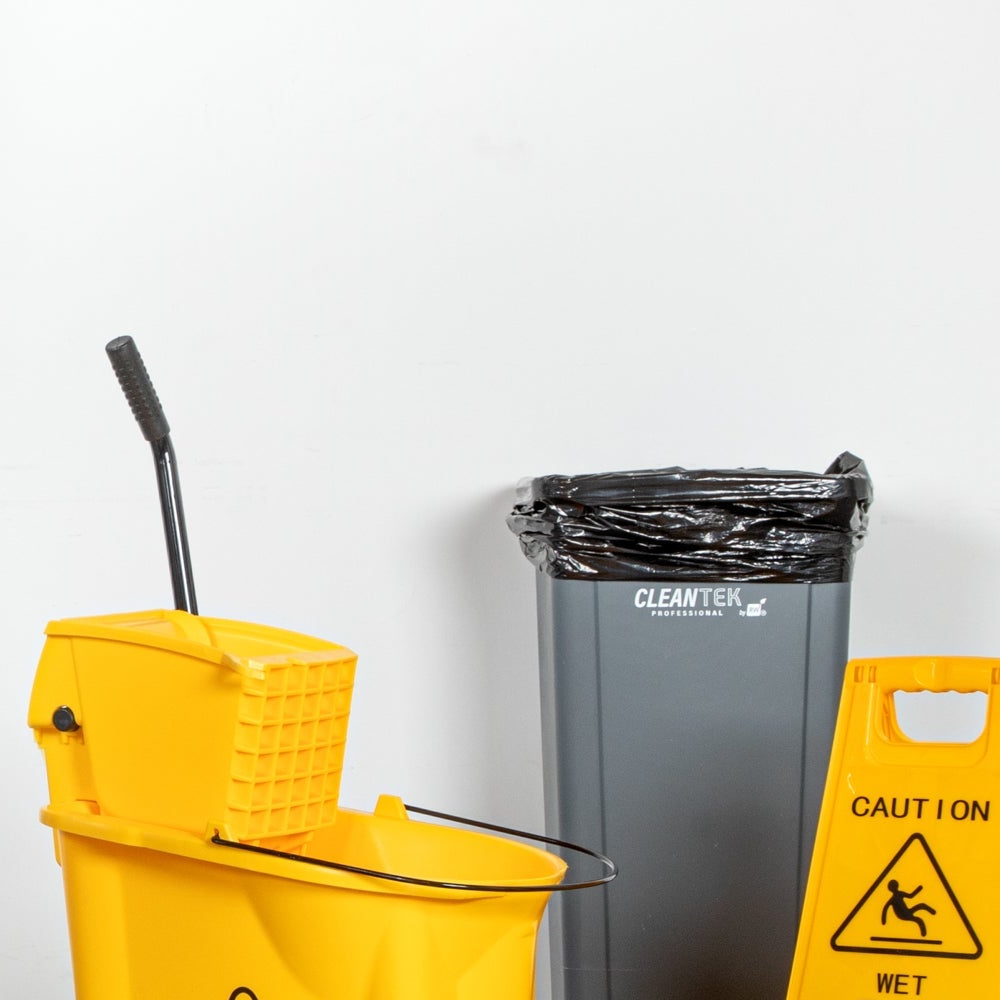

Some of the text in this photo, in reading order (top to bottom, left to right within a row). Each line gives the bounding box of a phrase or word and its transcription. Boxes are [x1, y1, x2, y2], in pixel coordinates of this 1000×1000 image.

[634, 587, 742, 608] CLEANTEK
[651, 609, 724, 617] PROFESSIONAL
[851, 796, 991, 821] CAUTION
[876, 972, 928, 996] WET
